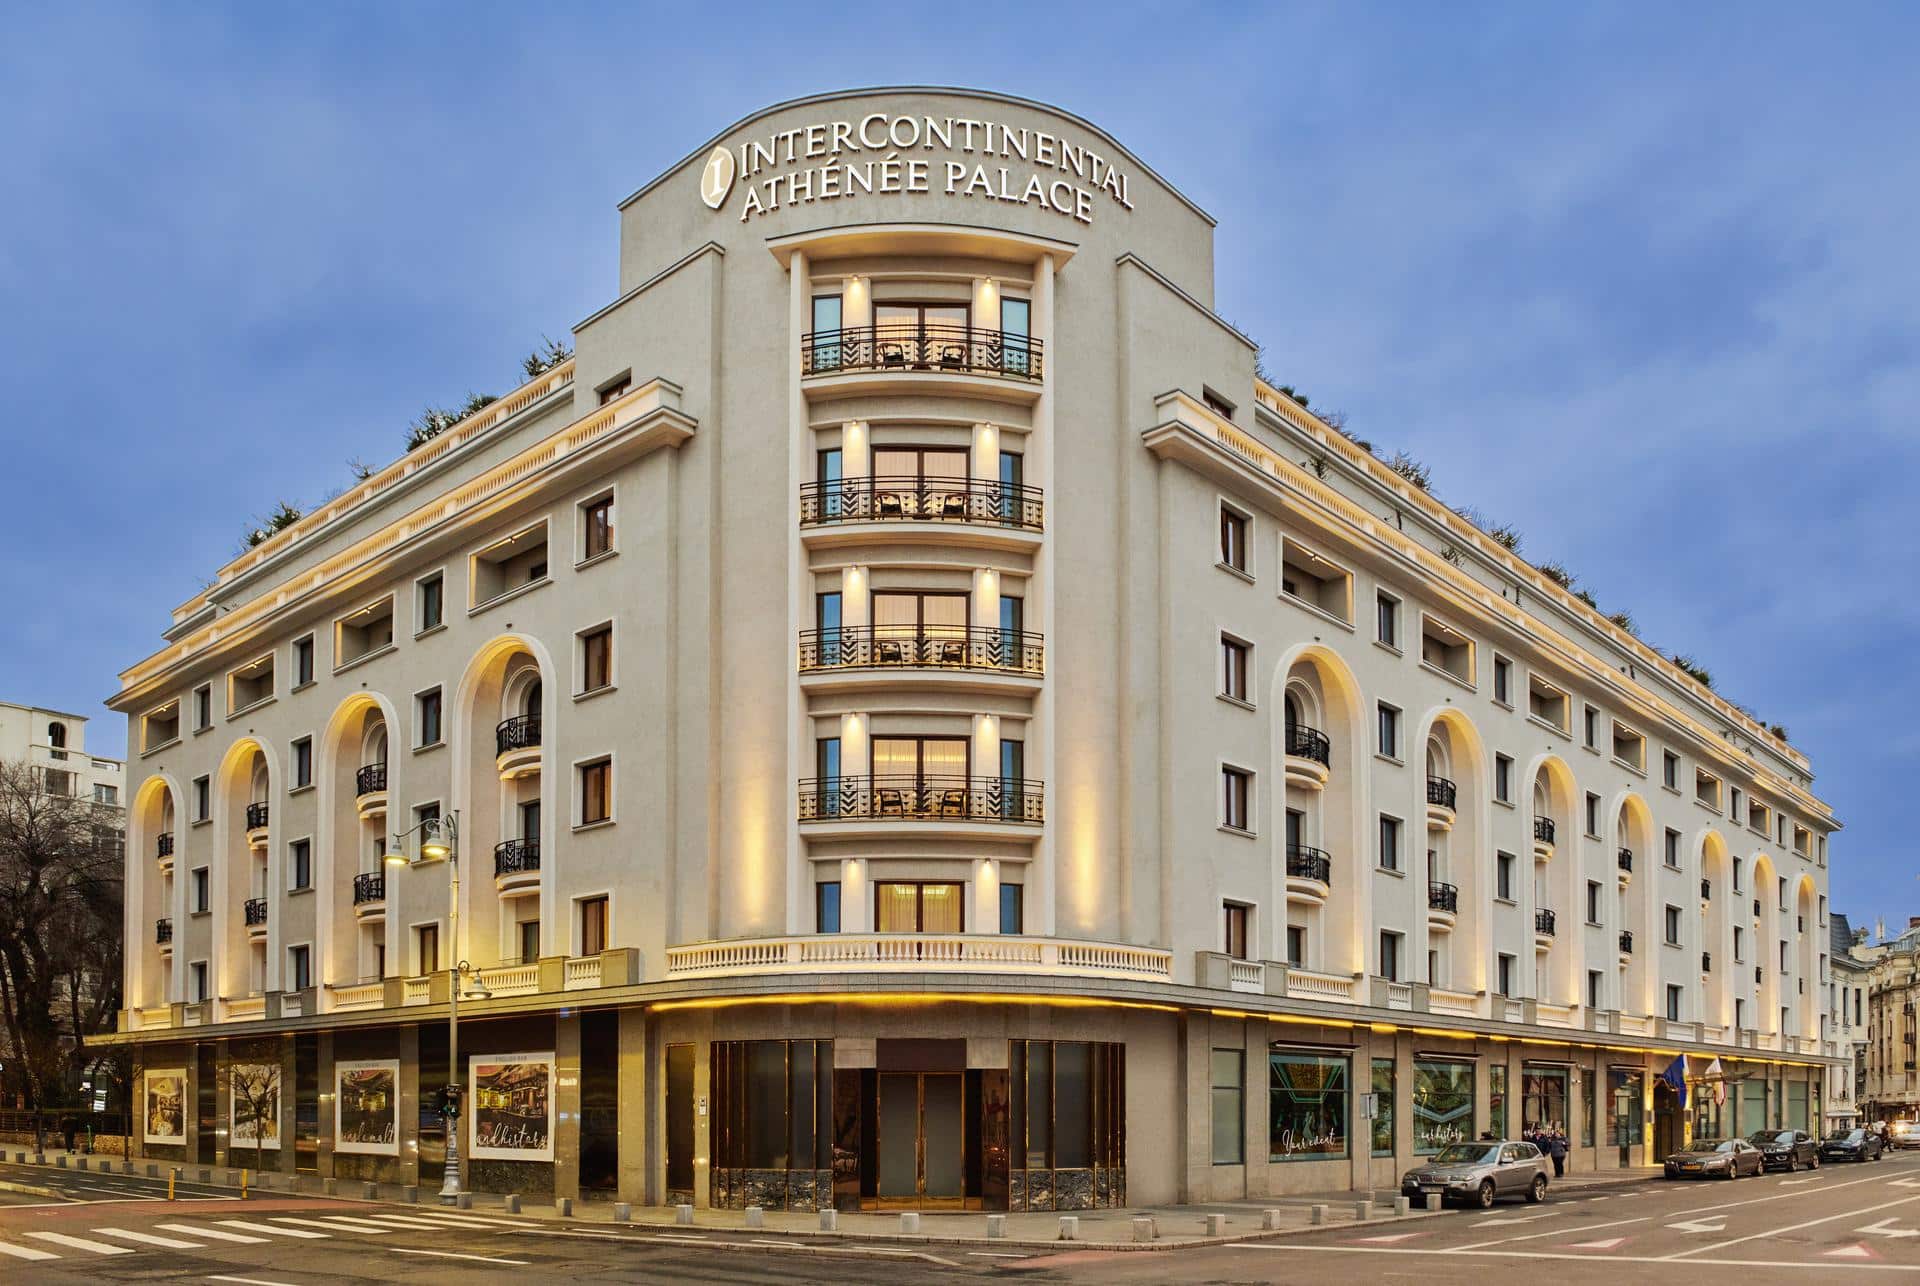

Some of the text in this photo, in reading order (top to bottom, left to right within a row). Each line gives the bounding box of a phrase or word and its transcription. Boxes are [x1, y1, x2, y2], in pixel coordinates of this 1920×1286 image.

[740, 113, 1133, 210] INTERCONTINENTAL
[740, 152, 1092, 223] ATHÉNÉE PALACE
